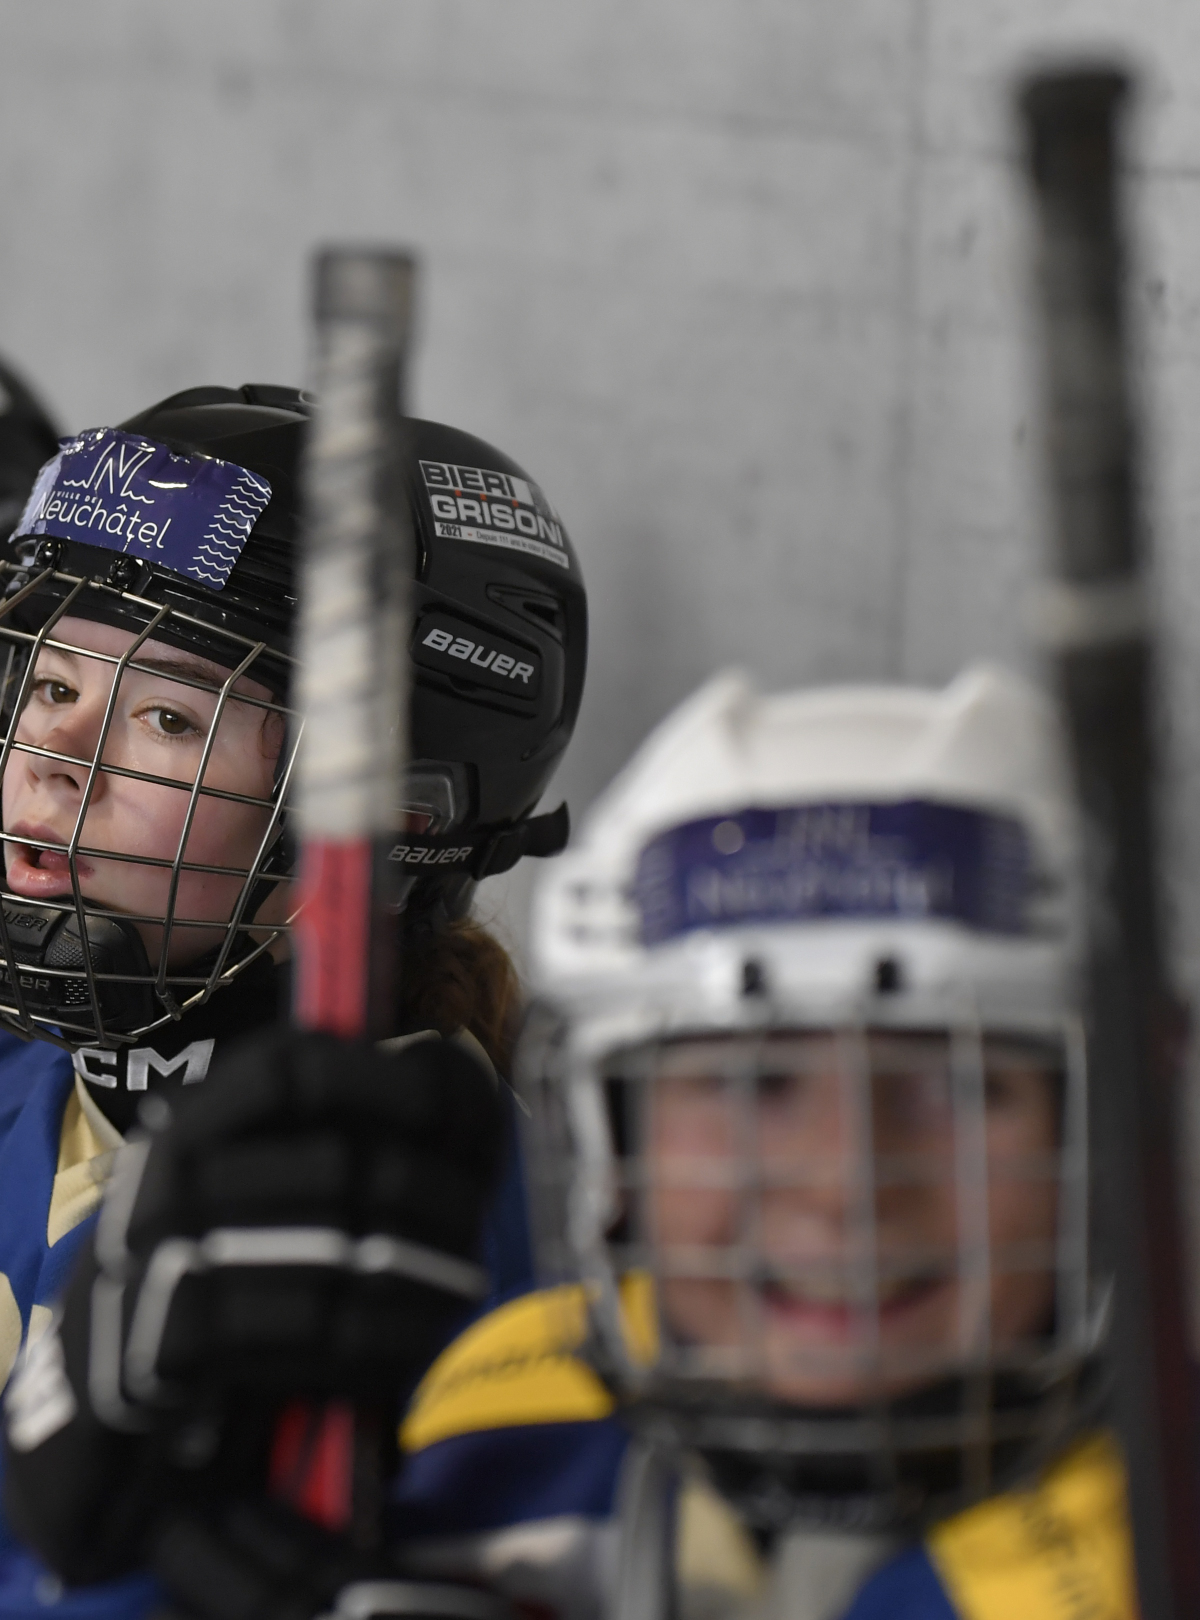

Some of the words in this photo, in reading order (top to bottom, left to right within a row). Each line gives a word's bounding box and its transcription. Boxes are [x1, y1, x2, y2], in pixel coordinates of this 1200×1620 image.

[56, 490, 81, 501] VILLE
[84, 494, 97, 504] DE
[422, 462, 516, 498] BIERI
[39, 491, 172, 549] Neuchâtel
[431, 494, 564, 548] GRISONI
[440, 523, 462, 538] 2021
[422, 628, 535, 684] BAUER
